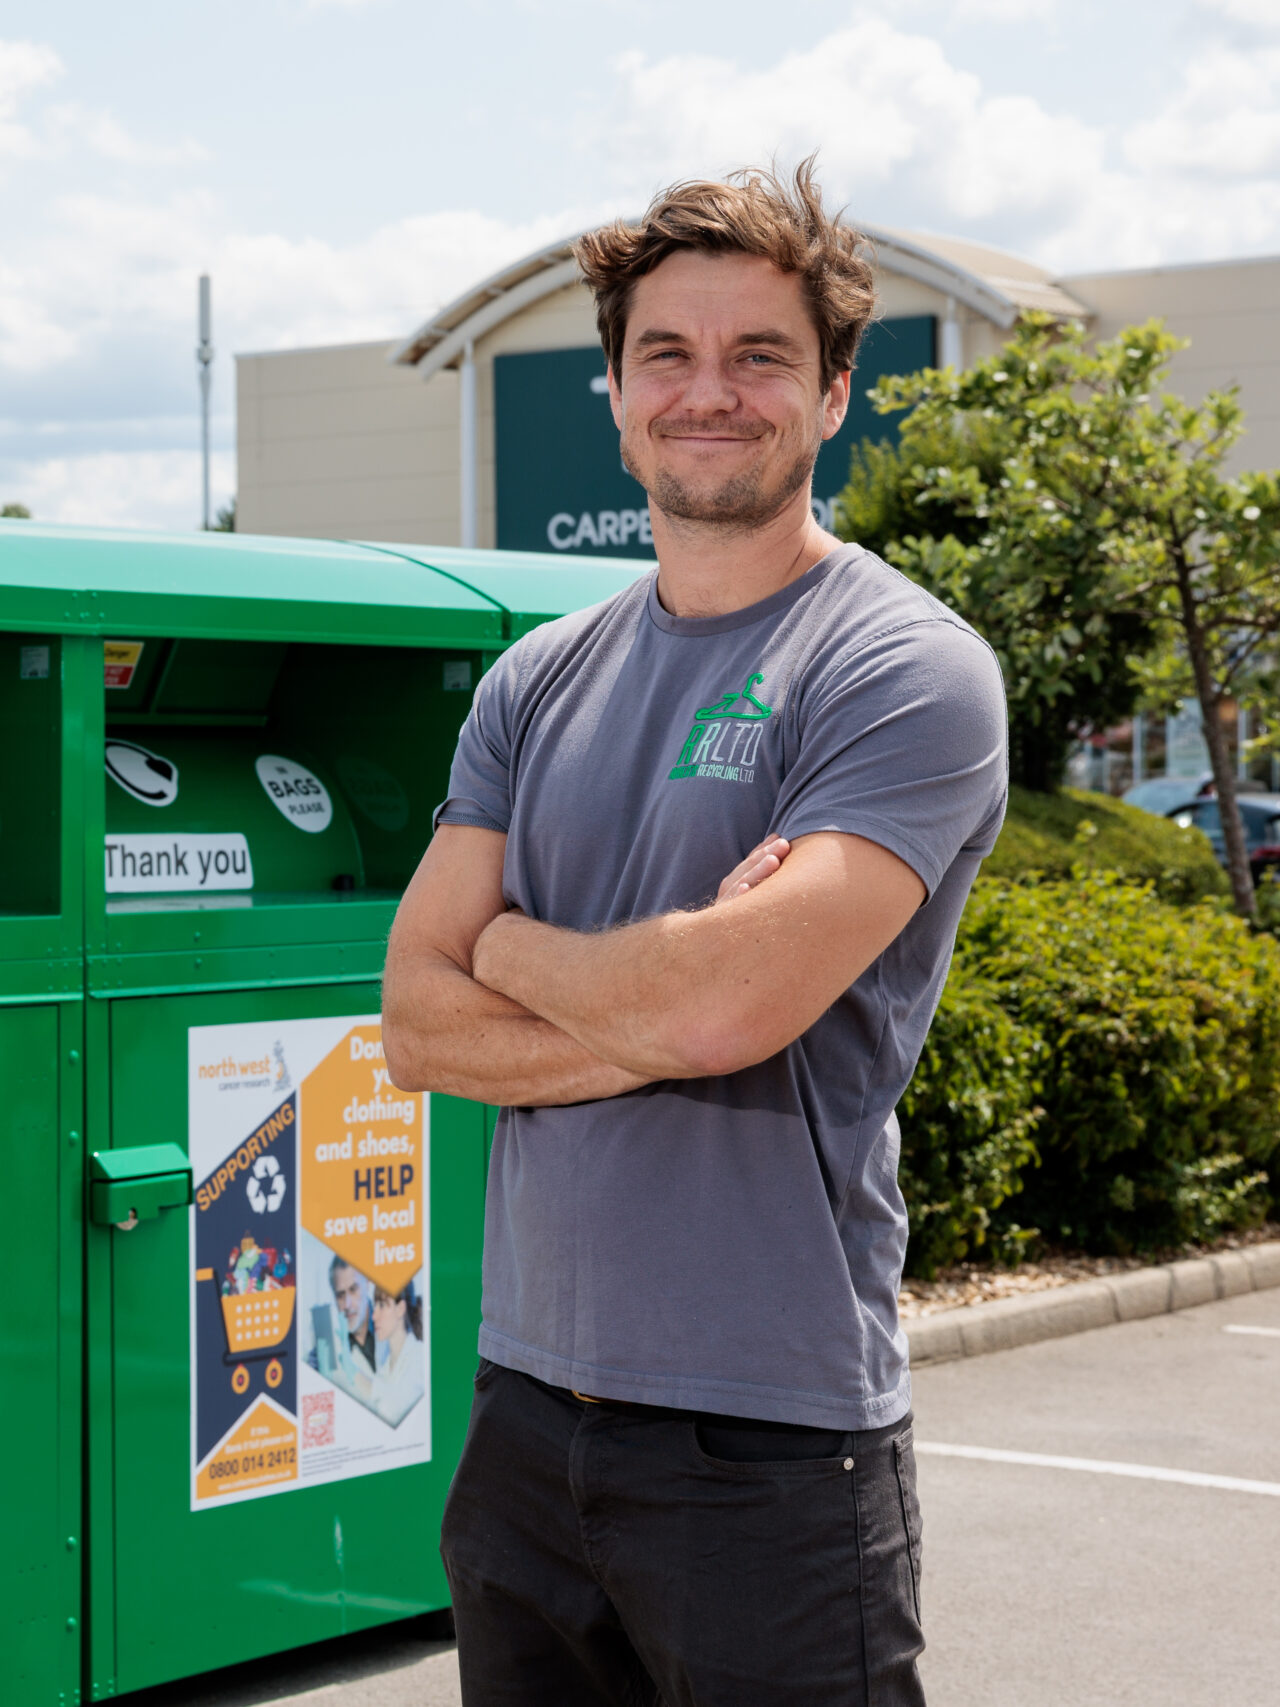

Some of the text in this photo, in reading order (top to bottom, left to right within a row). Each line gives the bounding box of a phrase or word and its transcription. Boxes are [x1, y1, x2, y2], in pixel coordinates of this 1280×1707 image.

[547, 508, 654, 550] CARPE
[697, 763, 739, 781] RECYCLING
[267, 778, 322, 798] BAGS
[288, 802, 326, 815] PLEASE
[105, 843, 247, 885] Thank you
[350, 1036, 387, 1061] Don
[198, 1053, 270, 1080] north west
[343, 1094, 414, 1125] clothing
[196, 1103, 296, 1212] SUPPORTING
[315, 1130, 415, 1162] and shoes,
[354, 1163, 414, 1201] HELP
[324, 1200, 415, 1238] save local
[374, 1239, 415, 1266] lives
[209, 1458, 239, 1480] 0800
[242, 1453, 264, 1473] 014
[268, 1447, 296, 1468] 2412
